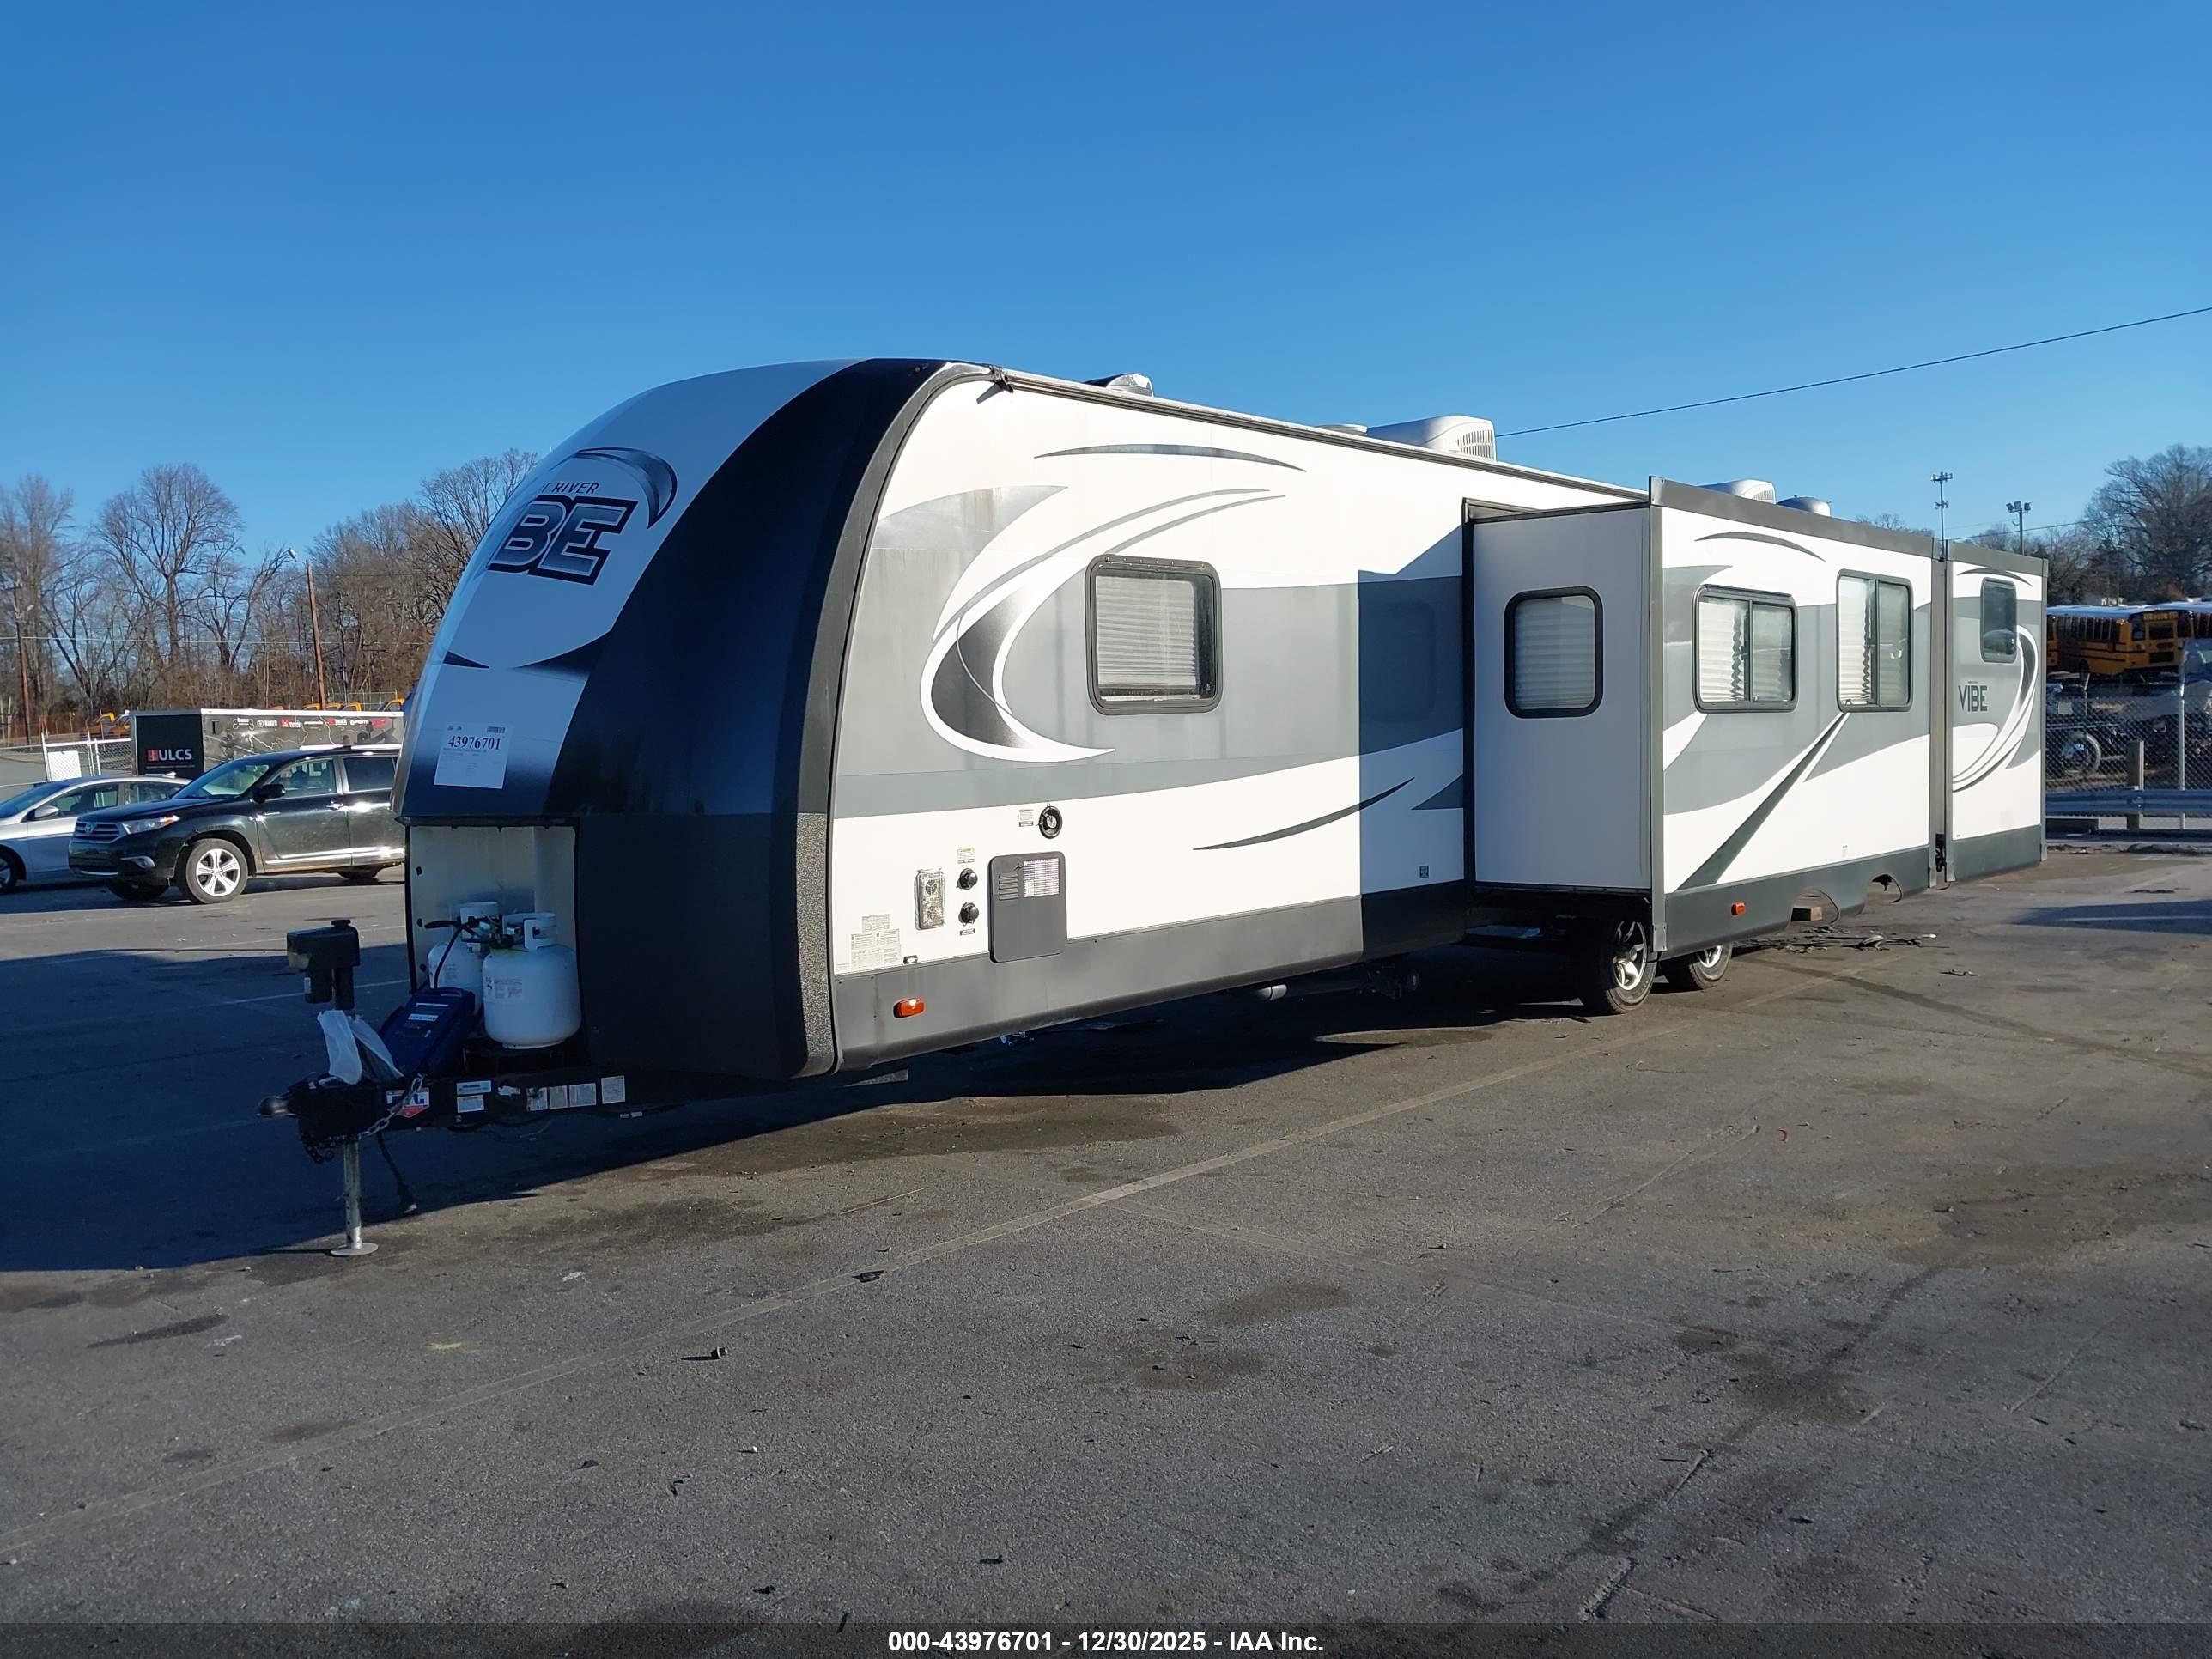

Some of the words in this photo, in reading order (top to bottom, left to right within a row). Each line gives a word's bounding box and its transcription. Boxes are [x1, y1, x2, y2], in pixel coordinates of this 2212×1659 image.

[551, 482, 599, 495] RIVER
[486, 494, 639, 586] BE
[1958, 684, 1988, 712] VIBE
[448, 735, 501, 750] 43976701
